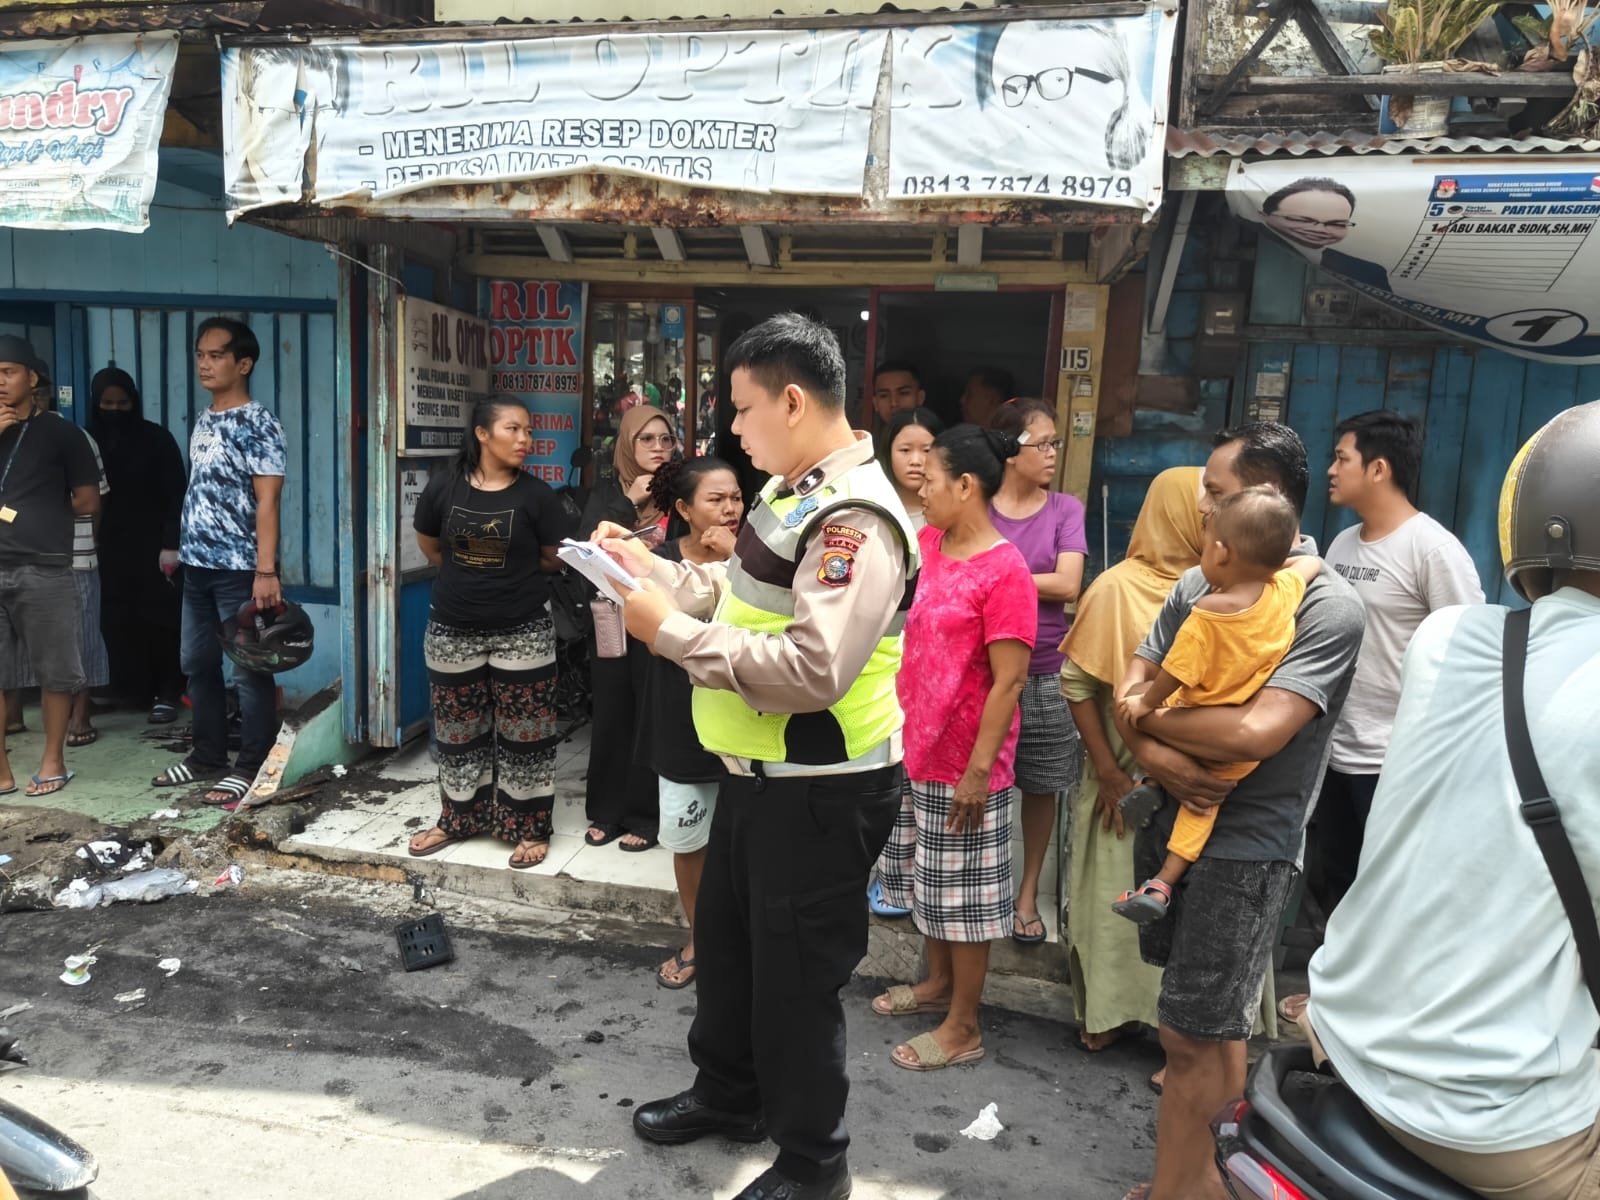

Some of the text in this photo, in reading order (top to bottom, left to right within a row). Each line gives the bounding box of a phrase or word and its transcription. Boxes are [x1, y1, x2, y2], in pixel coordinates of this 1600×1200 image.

[382, 119, 533, 160] MENERIMA
[542, 118, 642, 149] RESEP
[649, 119, 777, 153] DOKTER
[386, 154, 501, 190] PERIKSA
[600, 155, 713, 182] ATIS
[1061, 174, 1133, 198] 8979
[1429, 203, 1445, 217] 5
[1501, 205, 1546, 215] PARTAI
[1547, 204, 1600, 215] NASDEM
[1450, 223, 1475, 233] ABU
[1476, 223, 1515, 233] BAKAR
[488, 280, 571, 321] RIL
[1511, 314, 1576, 343] 1
[432, 312, 488, 370] RIL OPTIK
[490, 327, 577, 367] OPTIK
[1061, 349, 1088, 369] 115
[502, 373, 525, 391] 0813
[527, 373, 552, 391] 7874
[554, 373, 579, 391] 8979
[532, 413, 575, 431] RIMA
[525, 439, 558, 457] SEP
[521, 465, 565, 483] KTER
[826, 526, 863, 540] POLRESTA
